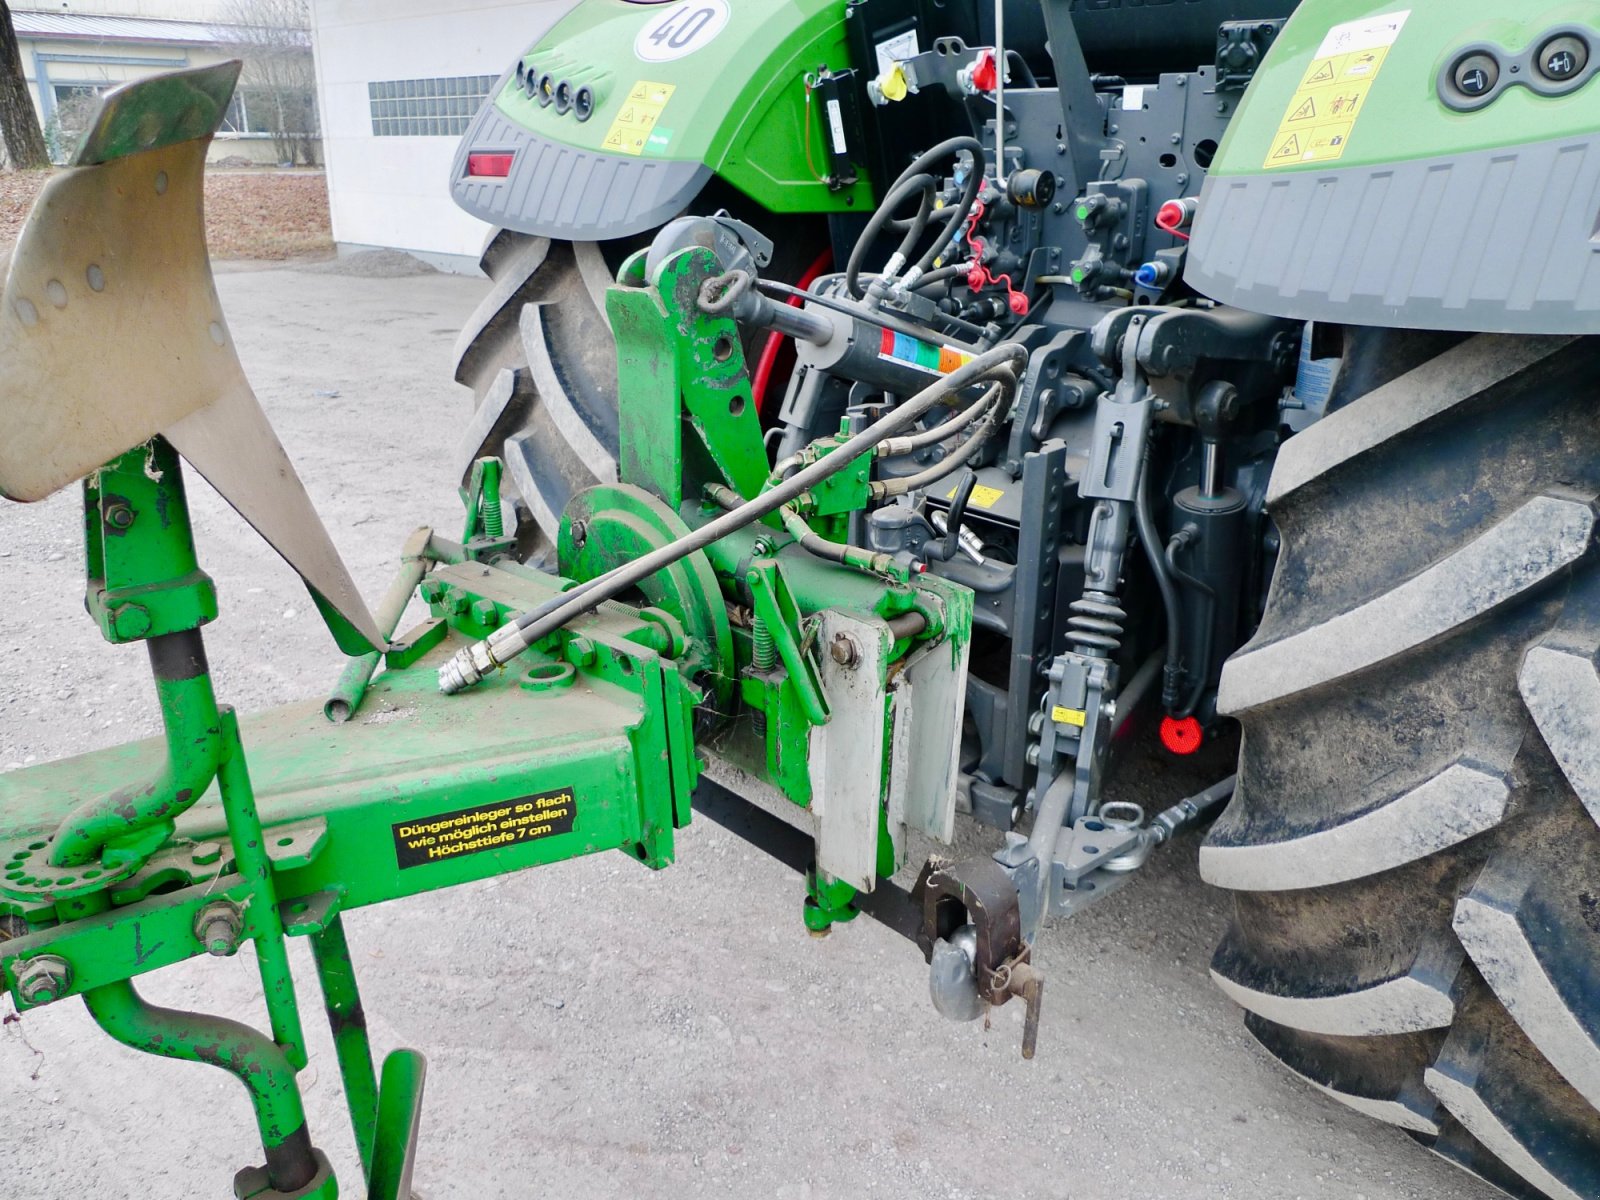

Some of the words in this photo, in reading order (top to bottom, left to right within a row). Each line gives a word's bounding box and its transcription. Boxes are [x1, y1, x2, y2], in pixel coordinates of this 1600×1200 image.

[648, 6, 716, 49] 40
[399, 807, 512, 839] Düngereinleger
[514, 802, 533, 813] so
[536, 793, 572, 809] flach
[408, 836, 436, 849] wie
[439, 822, 497, 844] möglich
[500, 807, 568, 830] einstellen
[428, 831, 515, 859] Höchsttiefe
[518, 827, 526, 839] 7
[529, 824, 552, 837] cm
